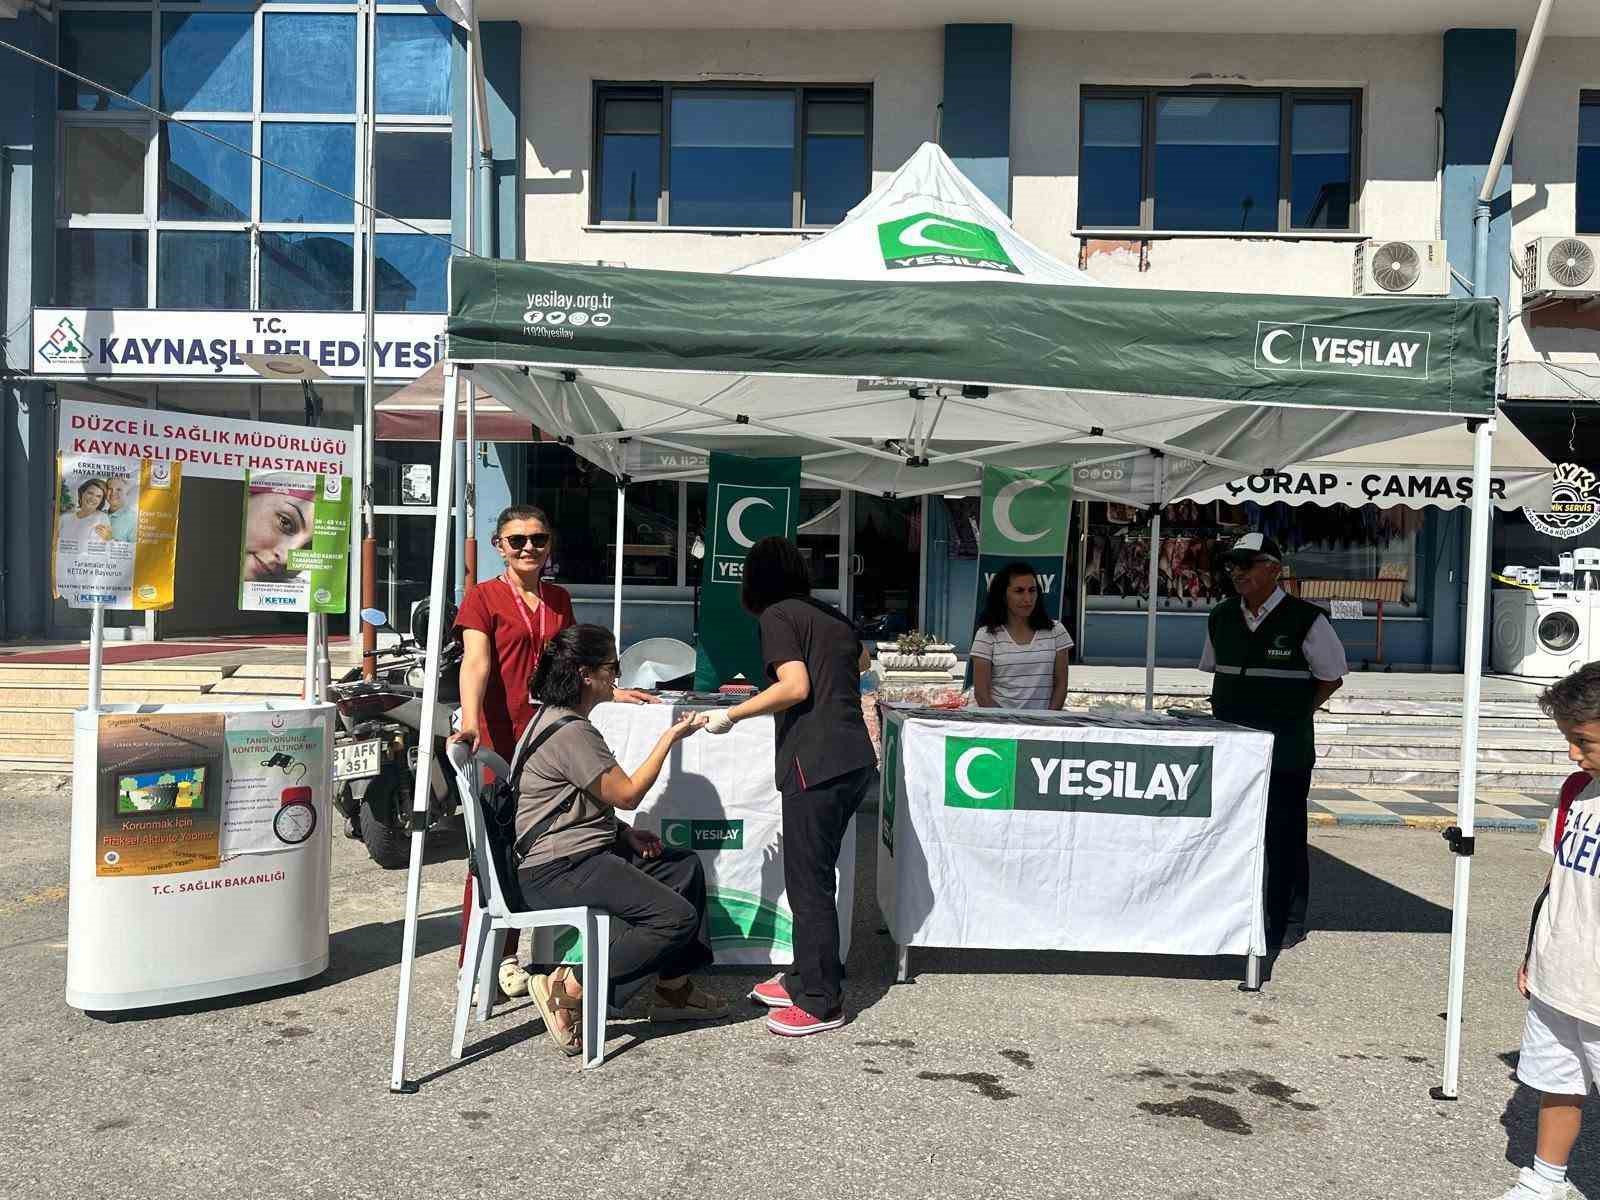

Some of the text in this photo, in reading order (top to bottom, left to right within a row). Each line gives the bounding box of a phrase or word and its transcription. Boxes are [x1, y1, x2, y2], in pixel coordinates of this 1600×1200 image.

[526, 290, 614, 311] yesilay.org.tr
[253, 317, 287, 334] T.C.
[99, 337, 254, 374] KAYNAŞLI
[1312, 336, 1420, 368] YEŞİLAY
[71, 414, 347, 455] DÜZCE İL SAĞLIK MÜDÜRLÜĞÜ
[176, 447, 244, 466] DEVLET
[248, 455, 343, 475] HASTANESİ
[73, 468, 95, 476] HAYAT
[1361, 473, 1507, 504] ÇAMAŞR
[1564, 504, 1592, 512] SERVİS
[80, 594, 118, 604] KETEM
[264, 596, 297, 605] KETEM
[232, 744, 271, 754] KONTROL
[354, 742, 377, 758] AFK
[346, 758, 368, 773] 351
[1030, 757, 1199, 801] YEŞİLAY
[153, 871, 286, 895] T.C. SAĞLIK BAKANLIĞI
